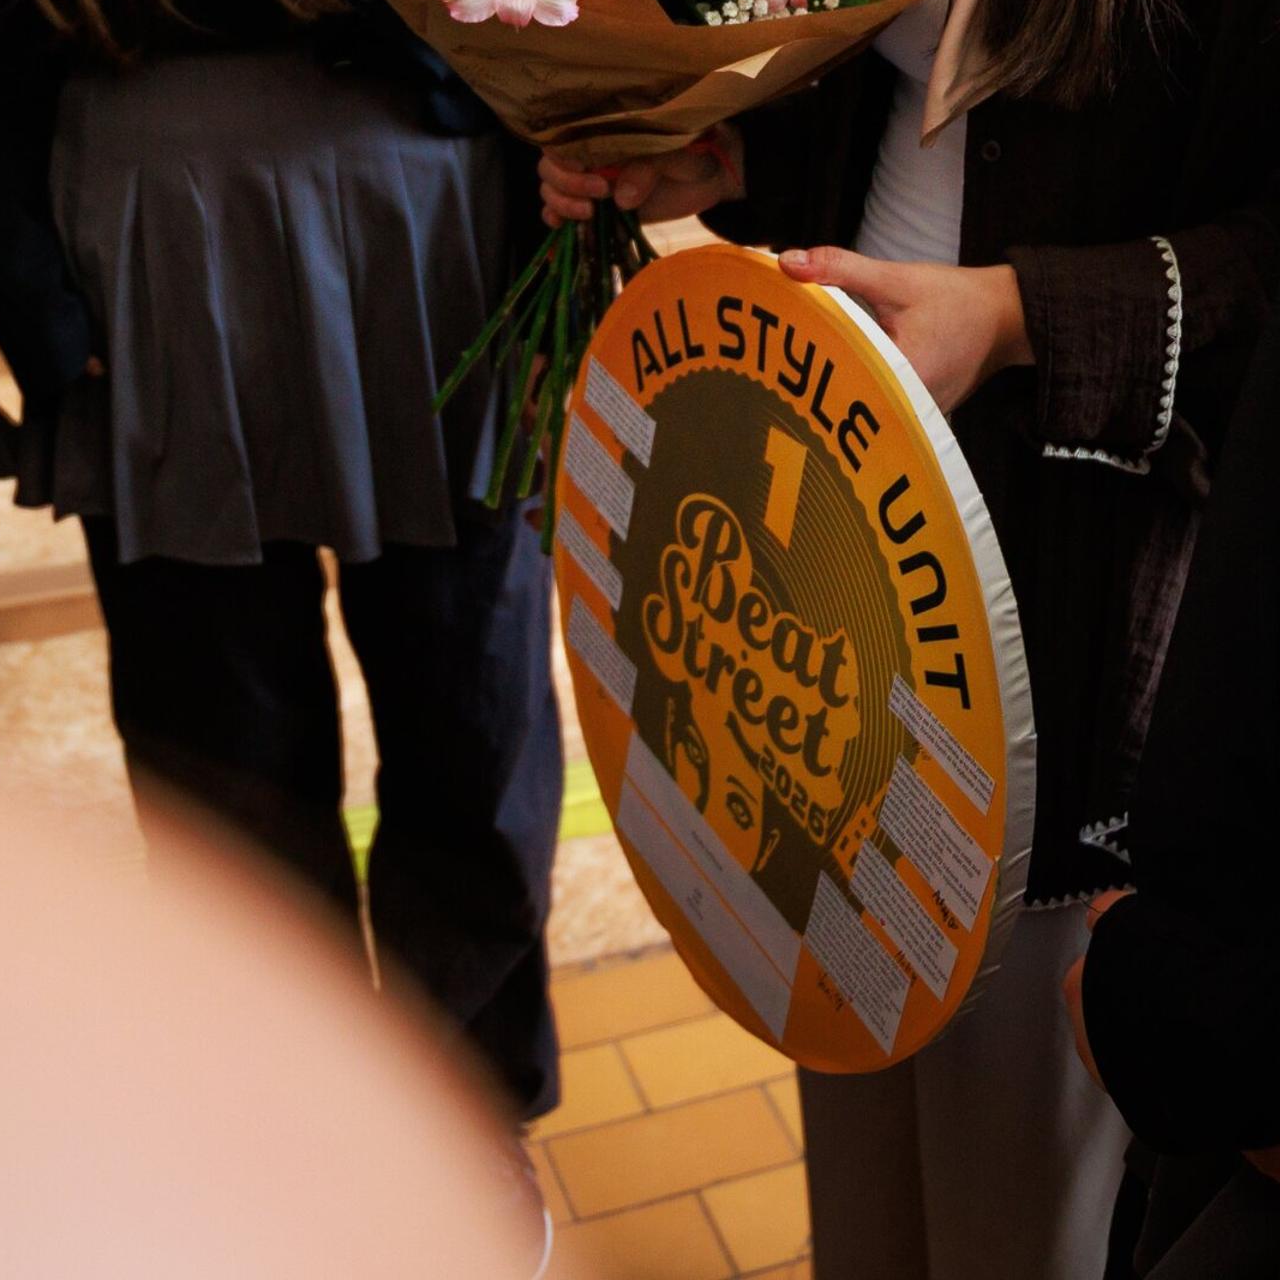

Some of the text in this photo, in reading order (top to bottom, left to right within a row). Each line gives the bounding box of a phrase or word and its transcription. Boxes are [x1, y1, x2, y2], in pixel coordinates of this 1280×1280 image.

[631, 298, 705, 393] ALL
[716, 295, 881, 474] STYLE
[878, 473, 971, 711] UNIT
[763, 424, 809, 552] 1
[645, 549, 832, 778] Street
[679, 499, 850, 709] Beat
[760, 743, 826, 838] 2026
